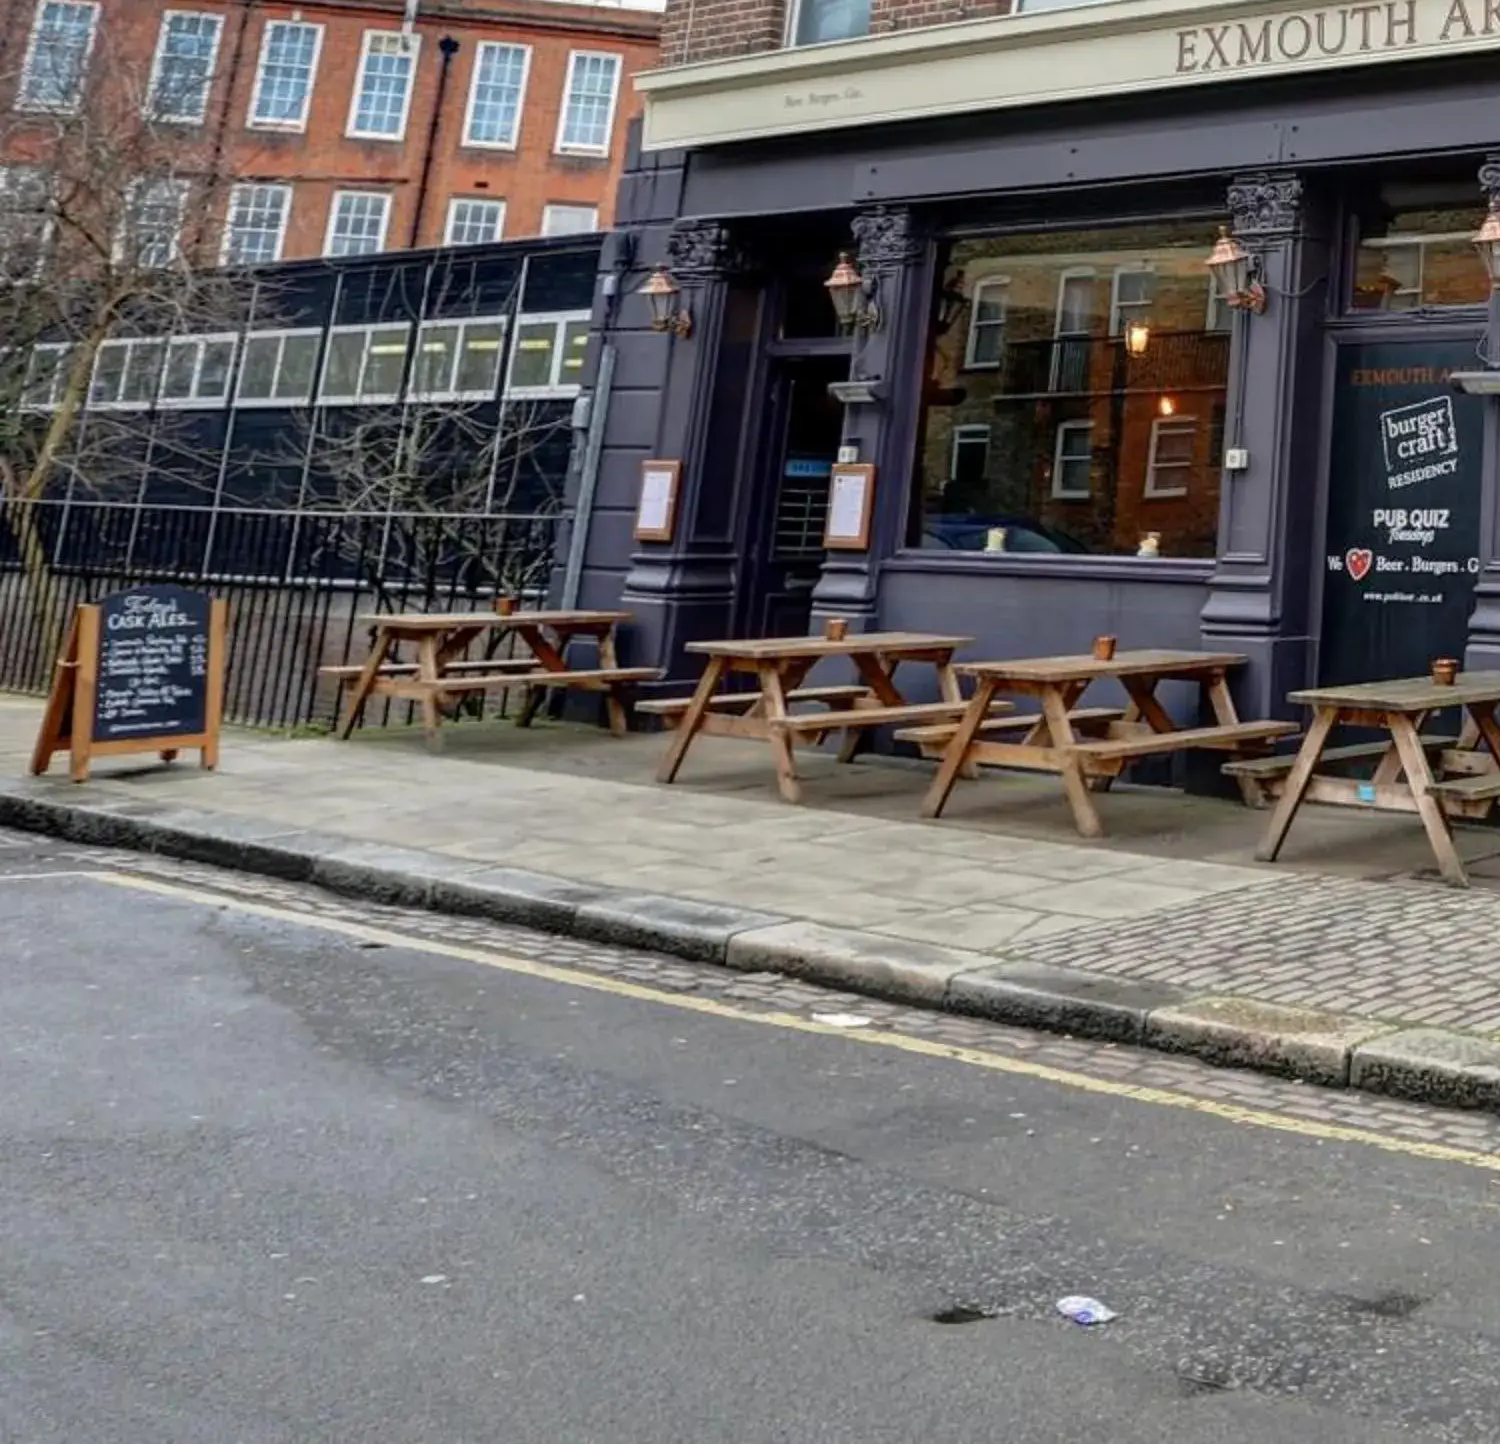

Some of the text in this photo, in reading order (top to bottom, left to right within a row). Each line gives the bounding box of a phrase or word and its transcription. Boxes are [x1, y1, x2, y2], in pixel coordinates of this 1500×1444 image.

[1386, 408, 1446, 439] burger
[1397, 426, 1447, 458] craft
[1387, 459, 1458, 489] RESIDENCY
[1373, 509, 1450, 530] PUB QUIZ
[1327, 555, 1344, 571] We
[107, 613, 146, 630] CASK
